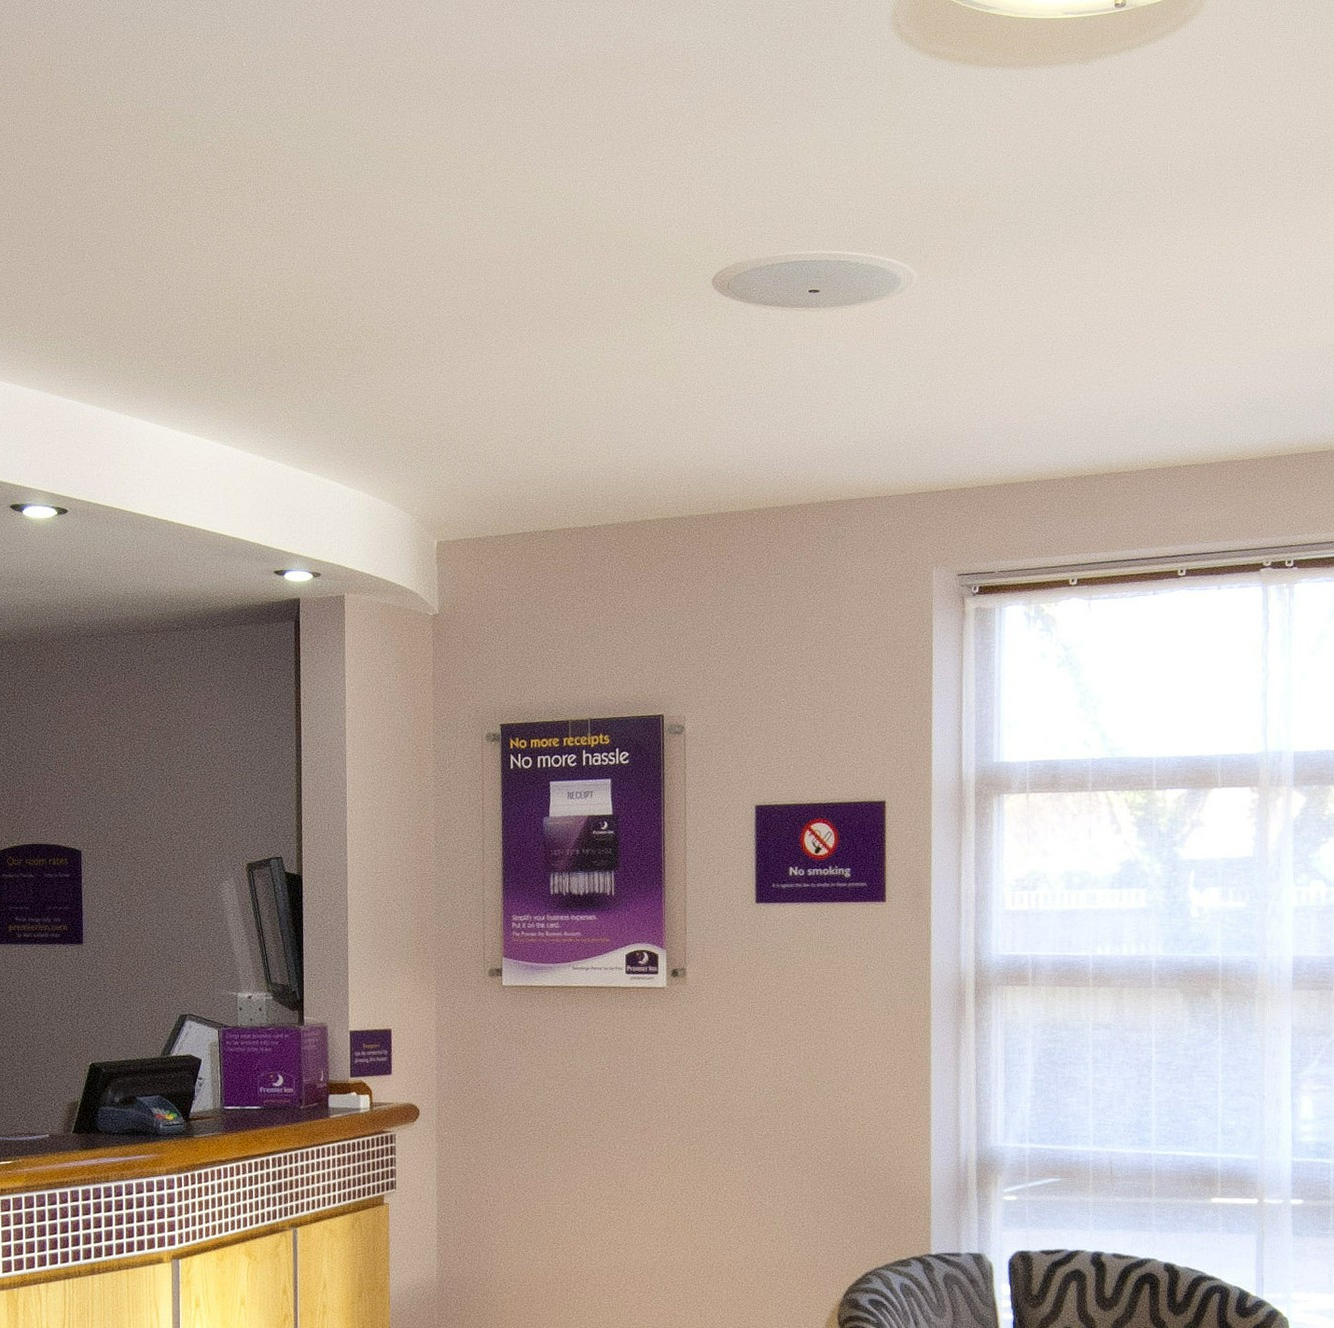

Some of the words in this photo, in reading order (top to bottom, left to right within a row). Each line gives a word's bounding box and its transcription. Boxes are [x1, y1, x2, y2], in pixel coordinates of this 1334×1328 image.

[509, 737, 527, 749] No
[530, 737, 560, 748] more
[563, 733, 610, 747] receipts
[510, 753, 533, 769] No
[537, 754, 577, 768] more
[582, 749, 630, 766] hassle
[567, 791, 593, 799] RECEIPT
[789, 866, 805, 876] No
[807, 866, 851, 878] smoking
